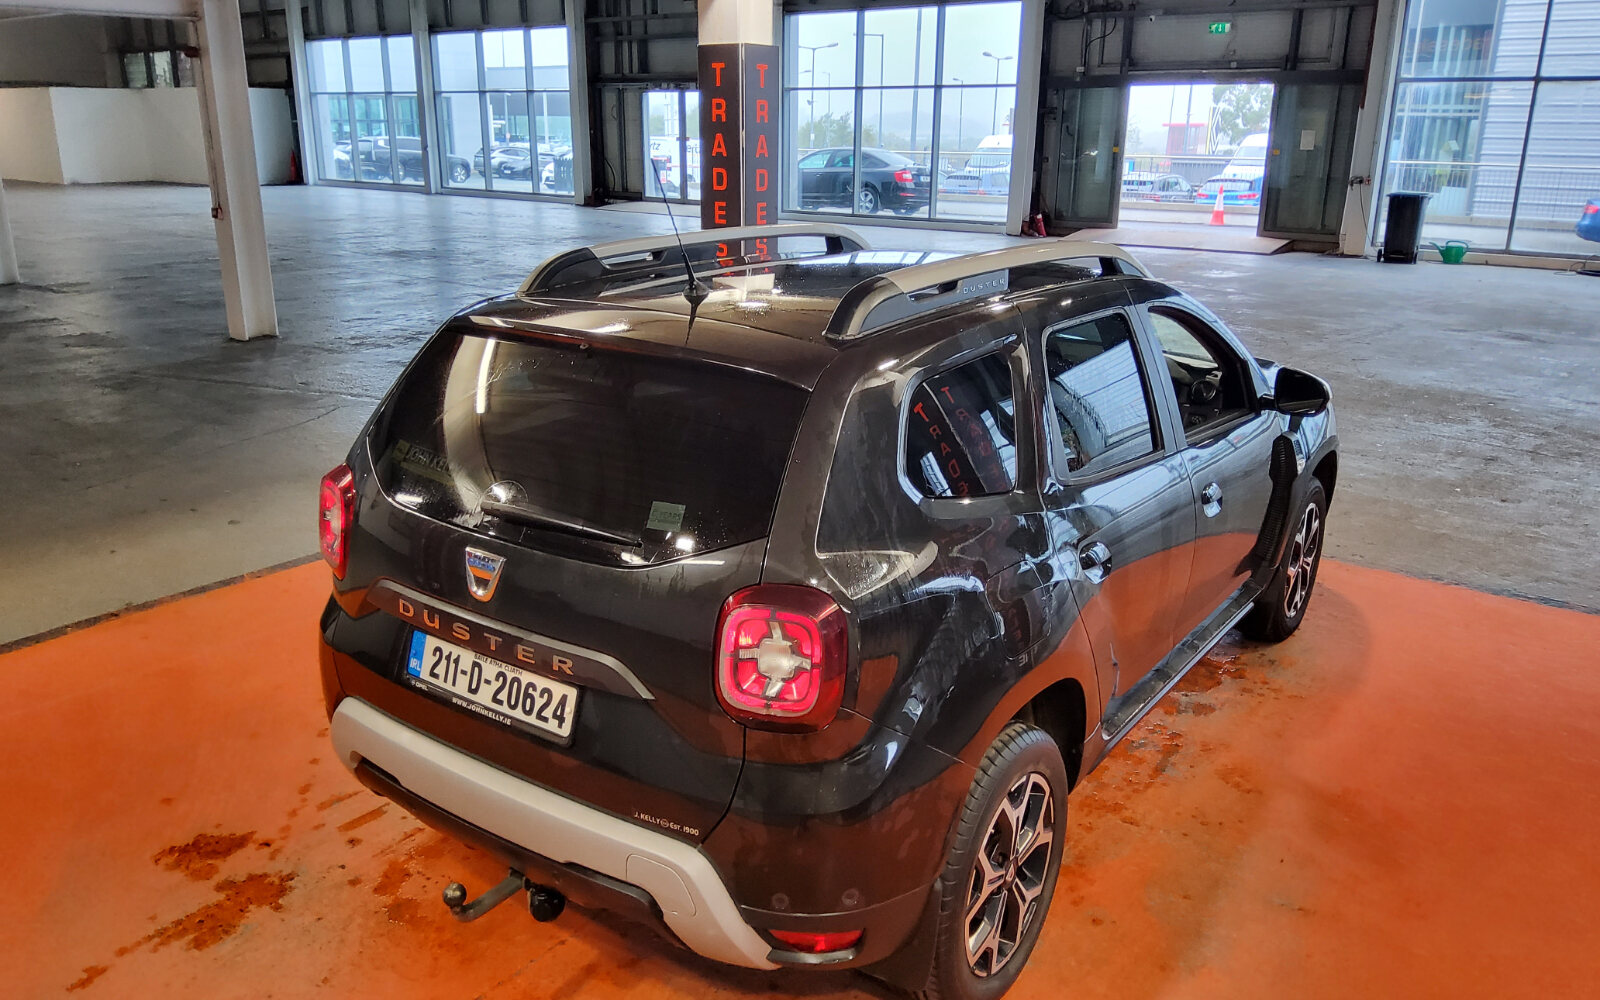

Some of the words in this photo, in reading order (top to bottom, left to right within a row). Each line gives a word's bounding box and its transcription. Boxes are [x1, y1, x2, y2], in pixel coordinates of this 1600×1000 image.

[963, 278, 1005, 294] DUSTER
[399, 598, 574, 676] DUSTER
[409, 658, 421, 672] IRL
[429, 645, 569, 730] 211-D-20624
[452, 697, 512, 726] WWW.JOHNKELLY.IE
[640, 812, 661, 825] KELLY
[683, 825, 700, 836] 1900
